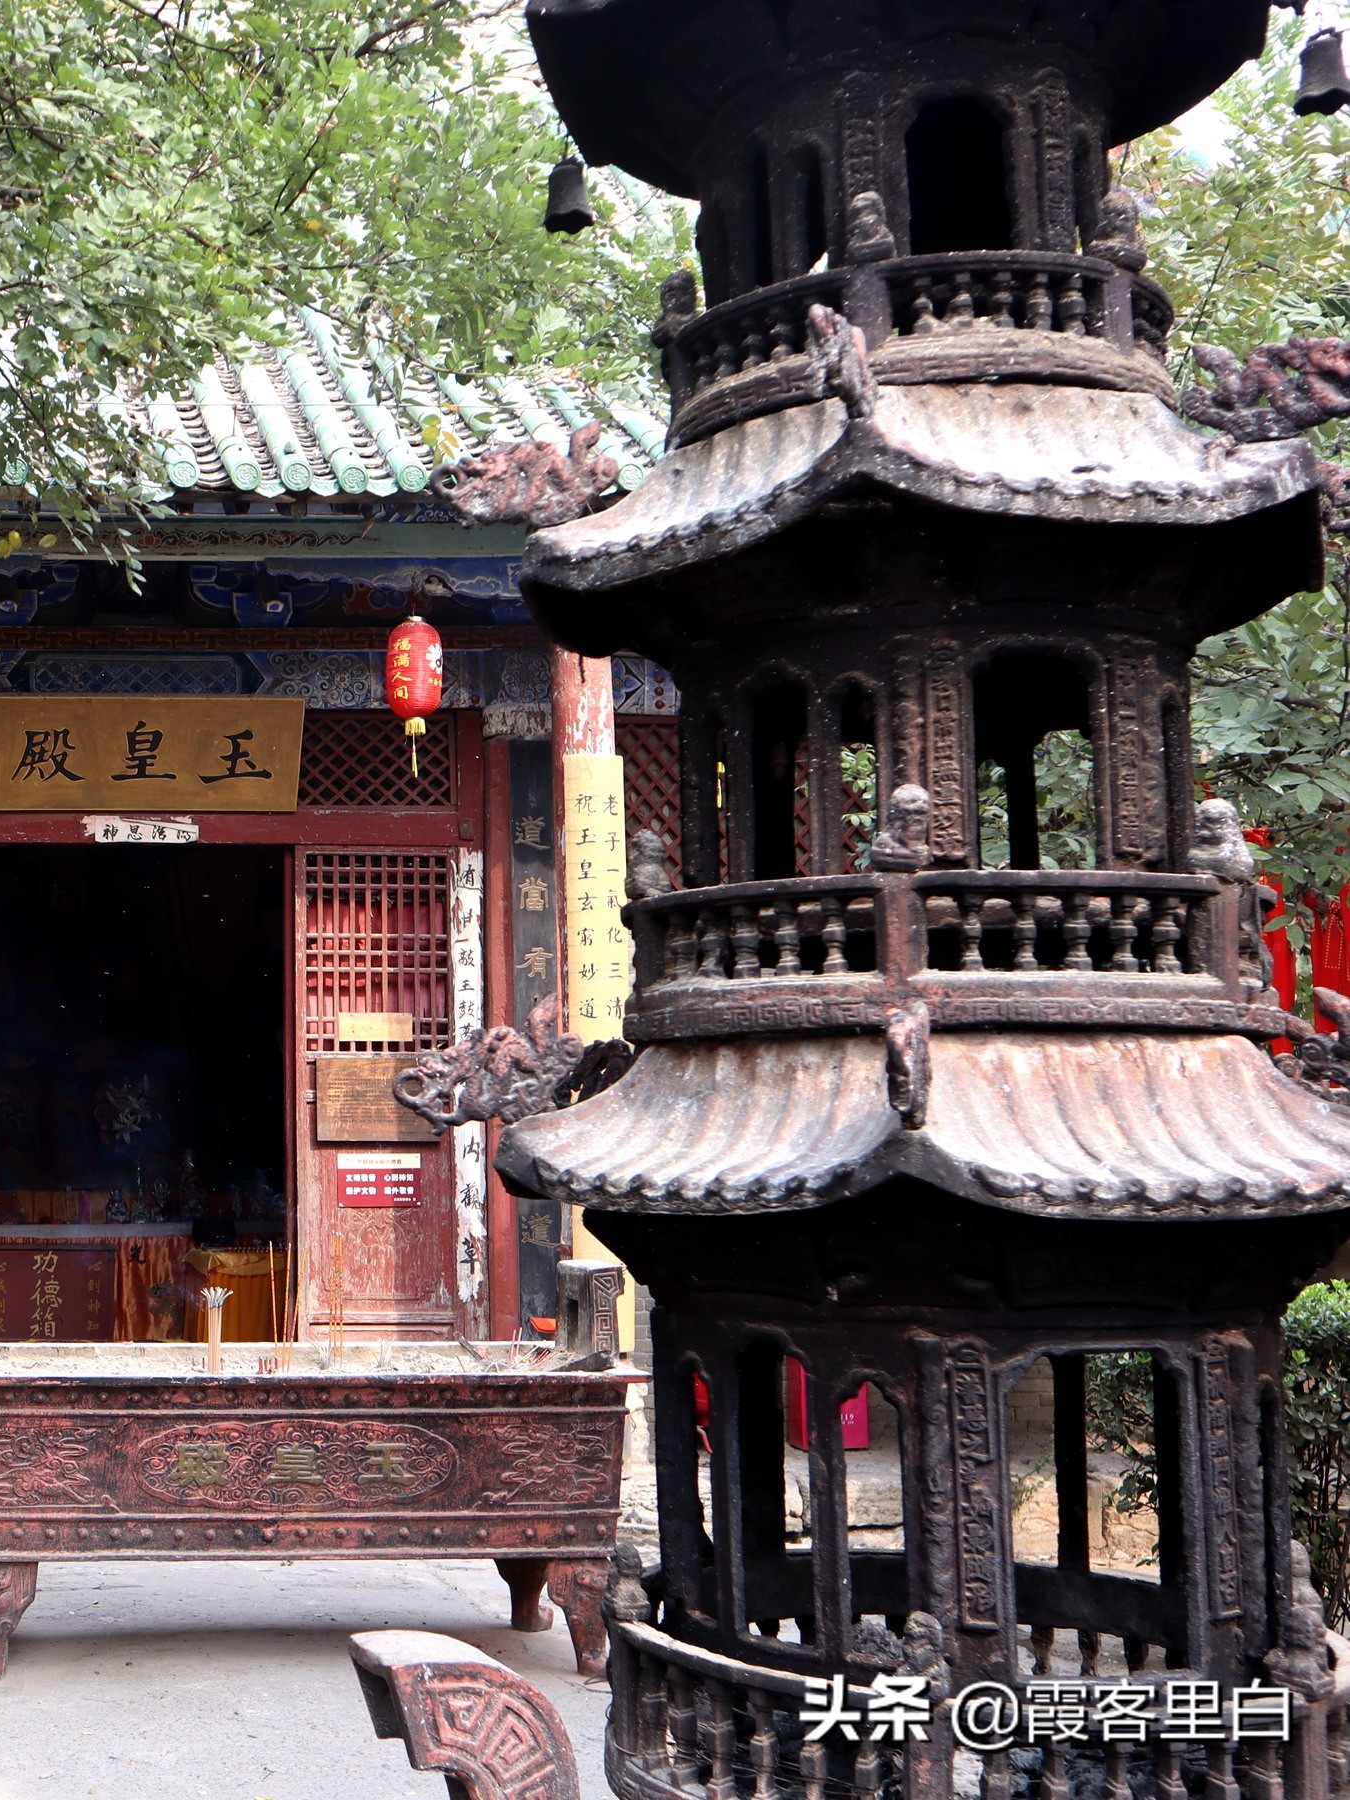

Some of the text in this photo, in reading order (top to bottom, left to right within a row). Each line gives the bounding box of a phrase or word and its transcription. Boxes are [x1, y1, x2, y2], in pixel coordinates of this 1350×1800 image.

[391, 637, 413, 700] 福满人间
[10, 719, 275, 785] 玉皇殿
[29, 1250, 63, 1339] 功德箱
[86, 1261, 103, 1332] 心到神知
[172, 1441, 418, 1488] 玉皇殿
